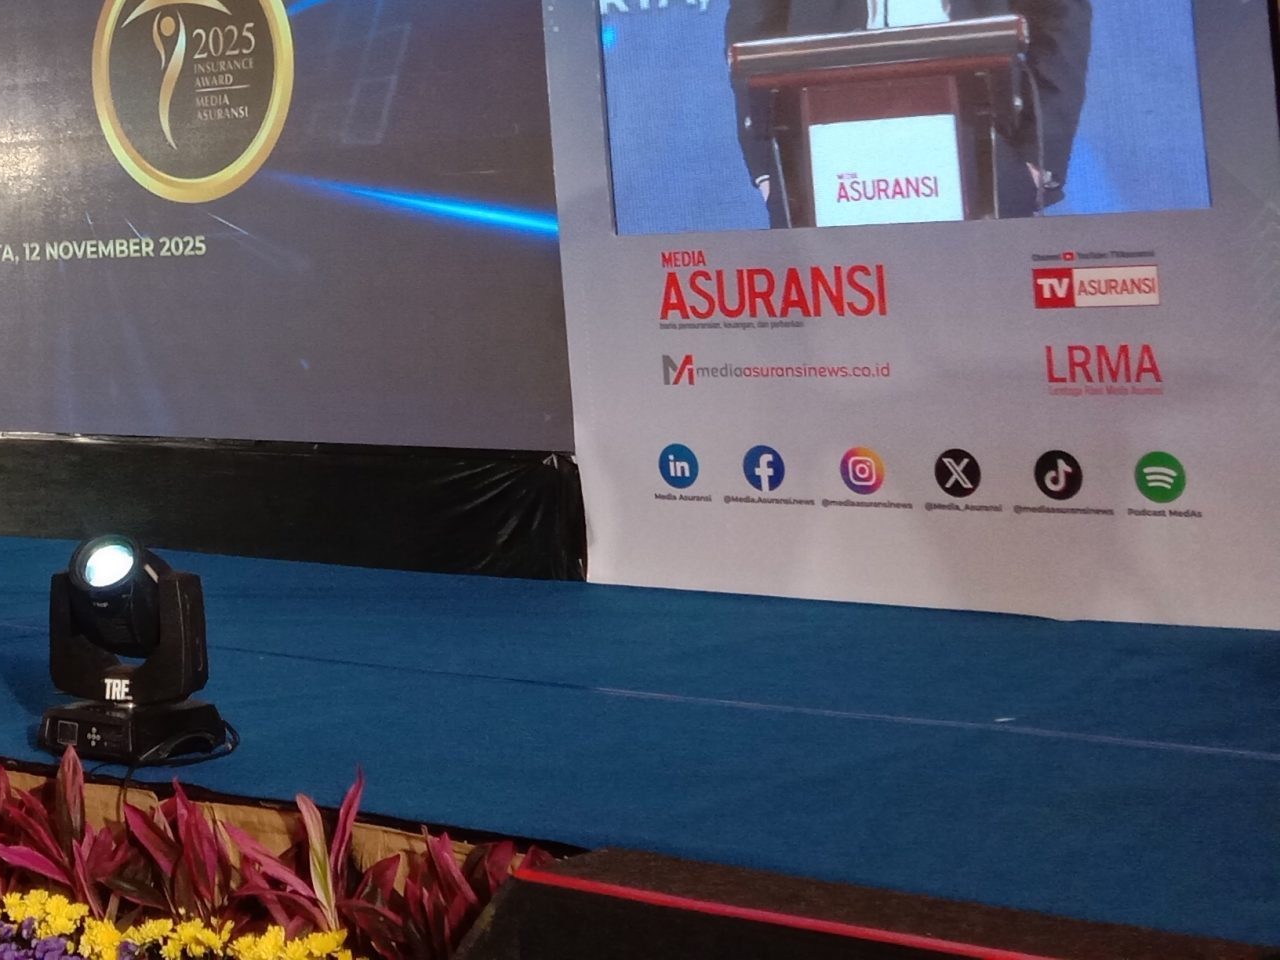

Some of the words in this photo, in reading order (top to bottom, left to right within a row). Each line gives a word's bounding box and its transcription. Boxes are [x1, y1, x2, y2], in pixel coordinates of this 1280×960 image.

[192, 22, 255, 59] 2025
[193, 58, 254, 74] INSURANCE
[195, 73, 233, 88] AWARD
[196, 93, 230, 108] MEDIA
[197, 105, 249, 121] ASURANSI
[836, 176, 939, 203] ASURANSI
[23, 242, 41, 260] 12
[46, 237, 155, 260] NOVEMBER
[159, 235, 207, 257] 2025
[661, 251, 706, 268] MEDIA
[660, 265, 887, 320] ASURANSI
[1036, 278, 1070, 298] TV
[1077, 277, 1156, 296] ASURANSI
[696, 362, 891, 378] mediaasuransinews.co.id
[1045, 344, 1163, 383] LRMA
[654, 493, 677, 501] Media
